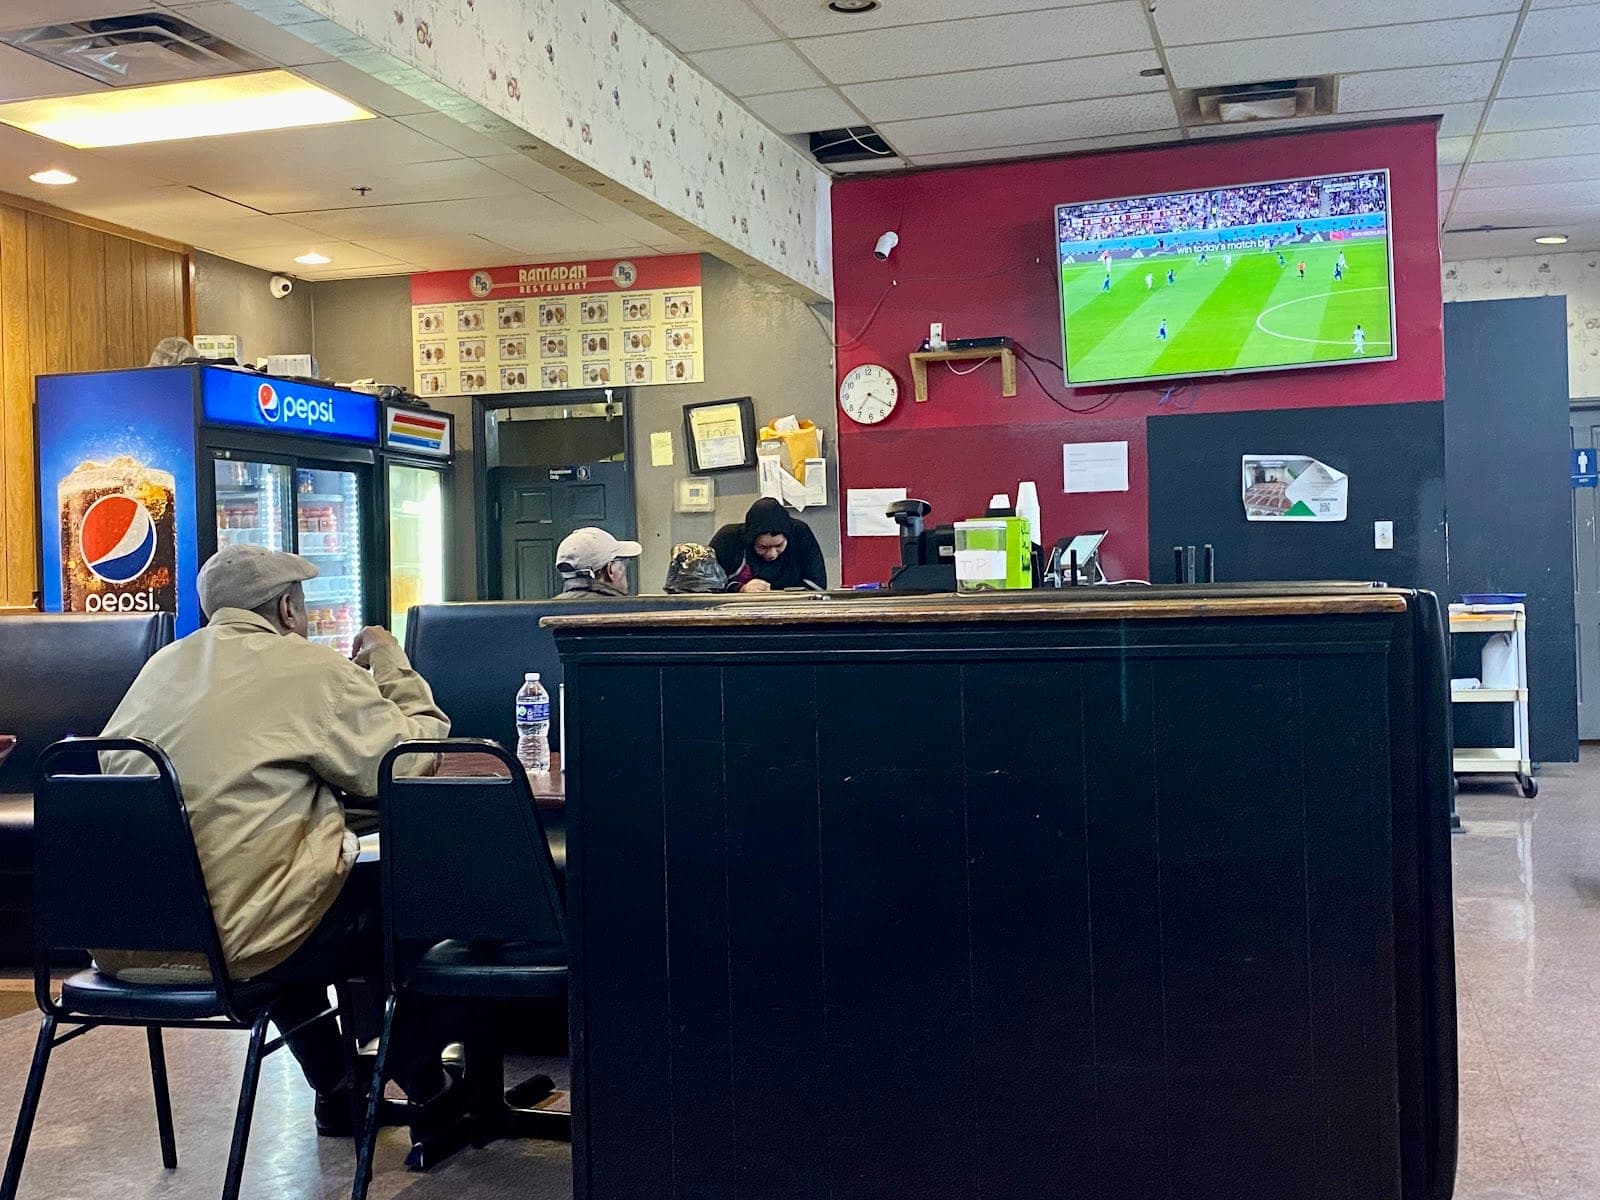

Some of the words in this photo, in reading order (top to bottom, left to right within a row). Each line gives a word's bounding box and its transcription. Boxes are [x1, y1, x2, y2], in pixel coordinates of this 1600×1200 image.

[1177, 246, 1192, 254] win
[1193, 243, 1226, 252] today's
[1228, 239, 1256, 250] match
[518, 265, 588, 282] RAMADAN
[618, 266, 633, 281] RR
[519, 281, 587, 294] RESTAURANT
[283, 396, 334, 426] pepsi
[85, 587, 155, 613] pepsi
